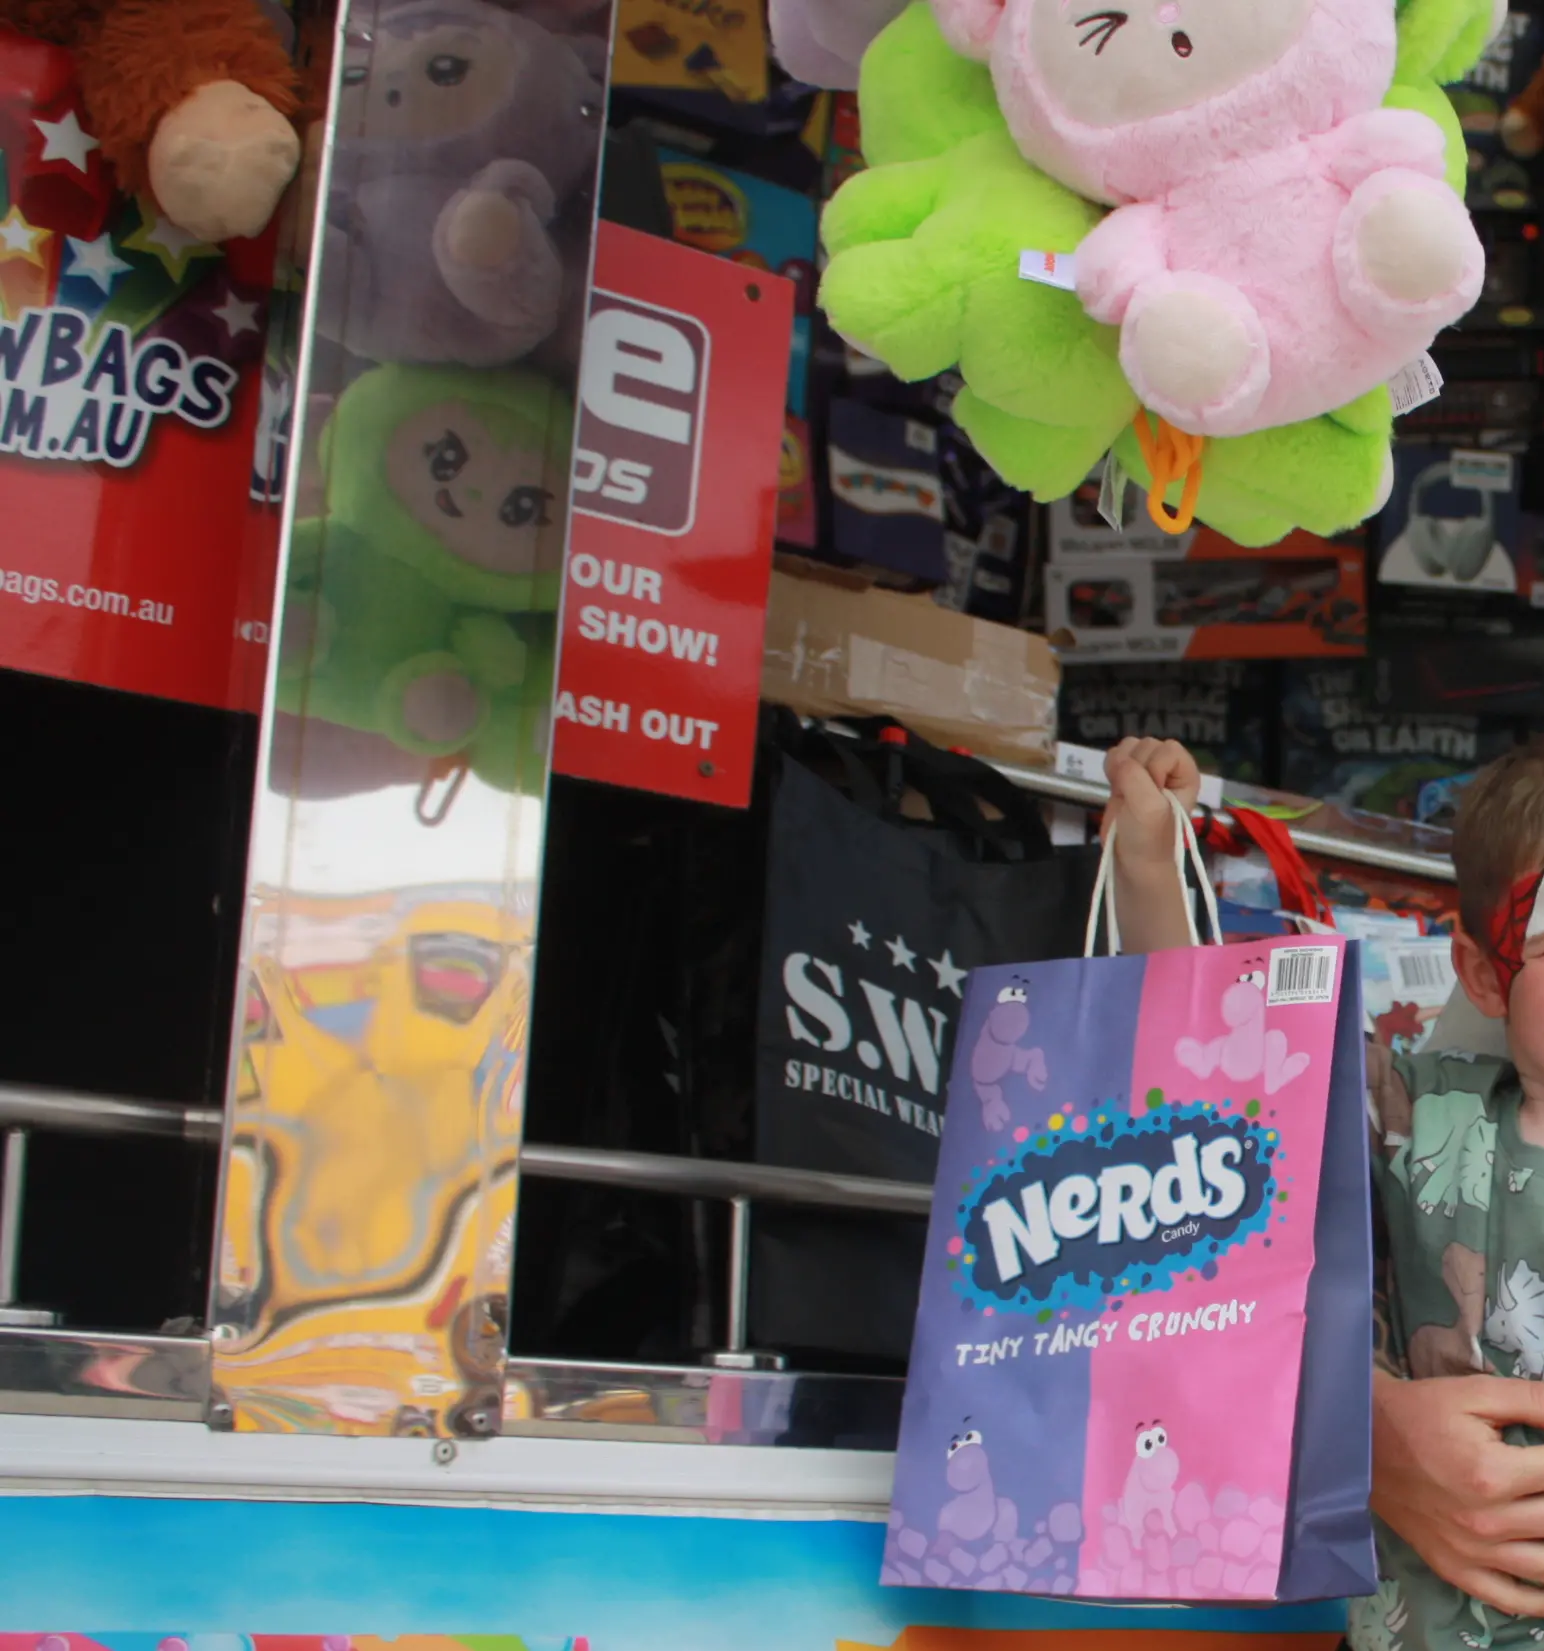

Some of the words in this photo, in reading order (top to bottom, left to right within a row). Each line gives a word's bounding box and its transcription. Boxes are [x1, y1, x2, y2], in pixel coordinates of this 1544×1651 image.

[0, 386, 146, 460] M.AU
[568, 551, 664, 605] OUR
[579, 605, 719, 667] SHOW!
[640, 709, 719, 750] OUT
[785, 1058, 892, 1116] SPECIAL
[894, 1095, 946, 1138] WEA
[1161, 1220, 1200, 1244] Candy
[956, 1338, 1022, 1367] TINY
[1034, 1319, 1118, 1358] TANGY
[1128, 1299, 1257, 1341] CRUNCHY
